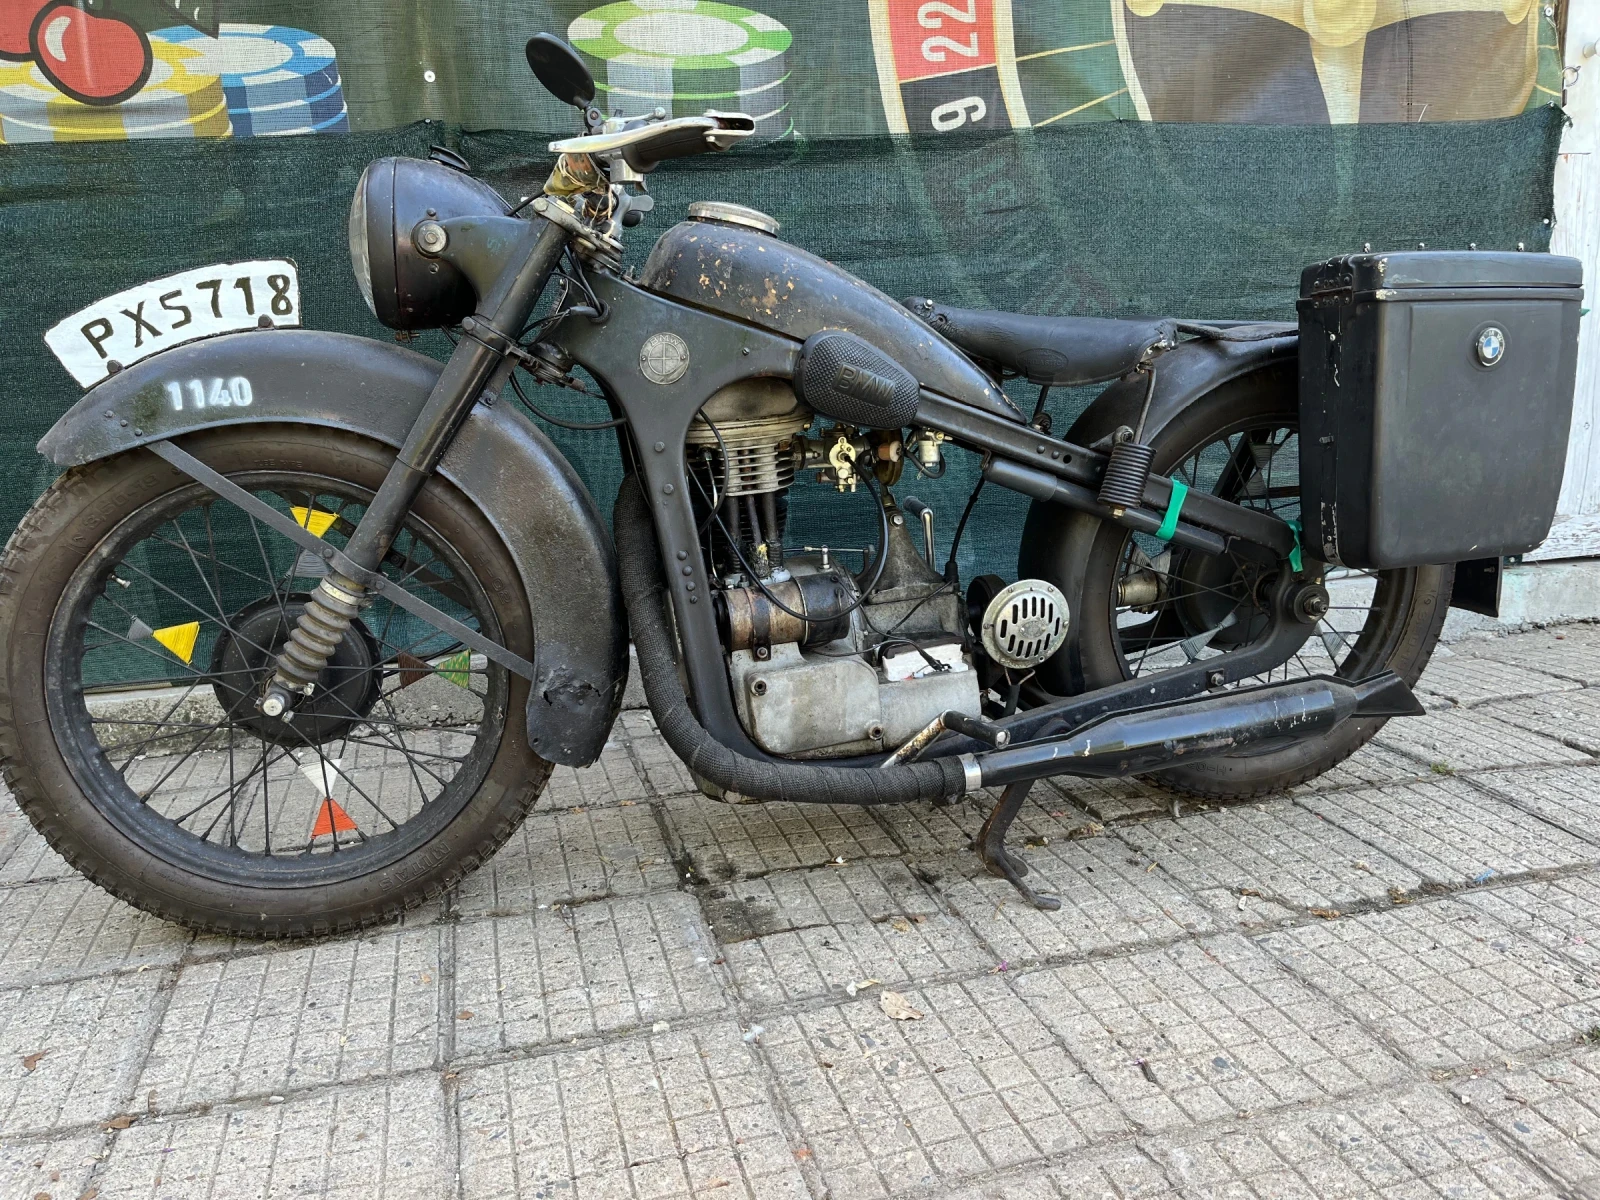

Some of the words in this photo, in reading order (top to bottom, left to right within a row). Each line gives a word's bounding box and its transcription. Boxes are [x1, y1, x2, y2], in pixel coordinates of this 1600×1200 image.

[917, 0, 979, 62] 22
[649, 334, 682, 346] BMW
[166, 375, 253, 411] 1140
[839, 363, 895, 400] BMW
[379, 841, 450, 891] MITAS
